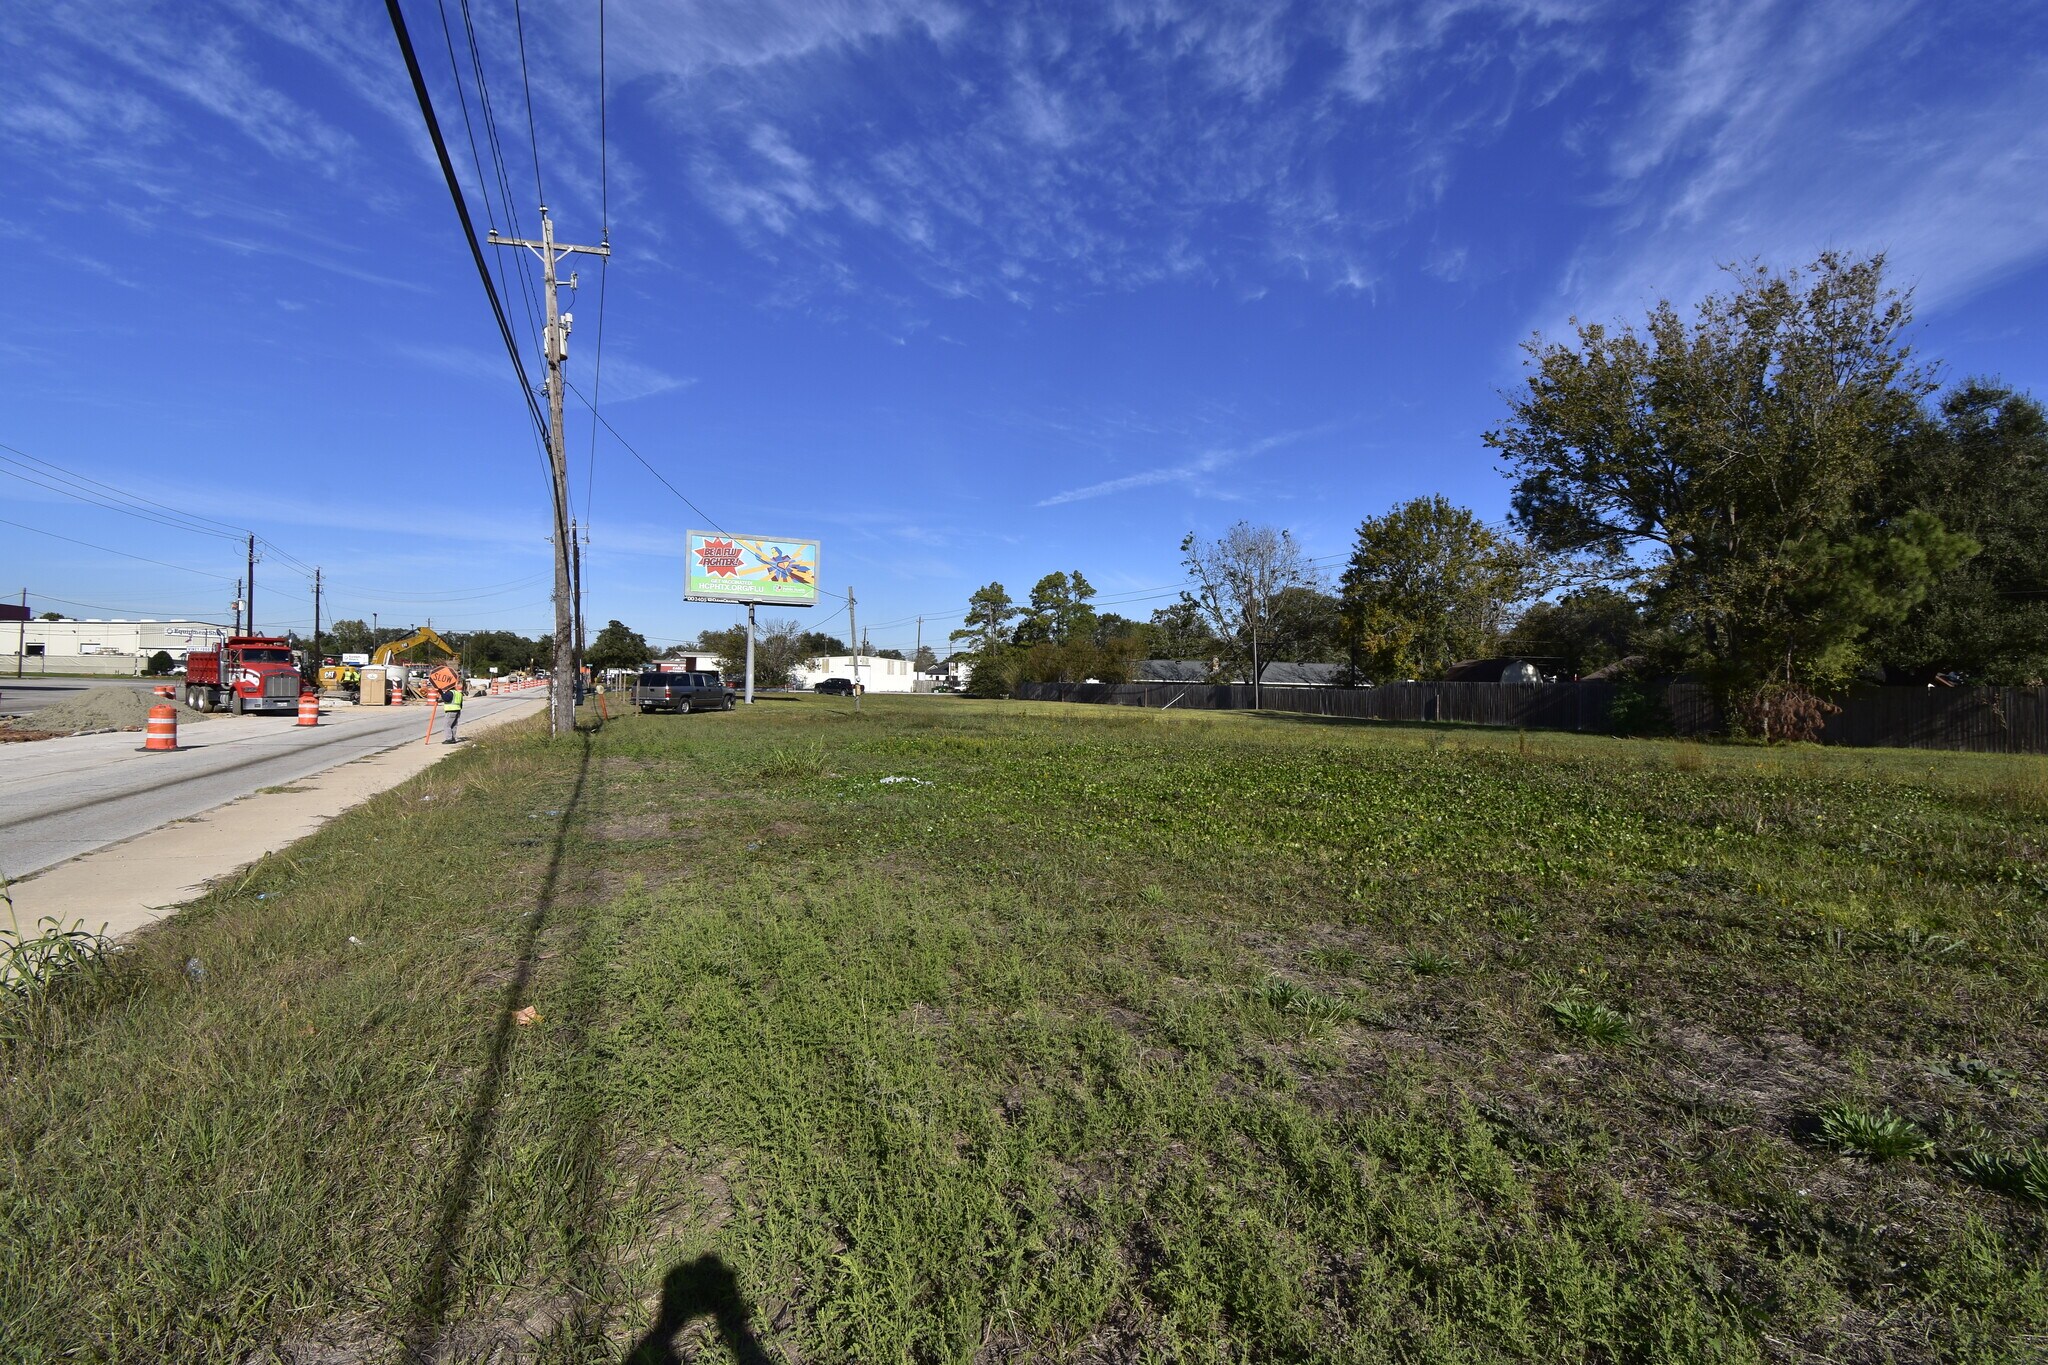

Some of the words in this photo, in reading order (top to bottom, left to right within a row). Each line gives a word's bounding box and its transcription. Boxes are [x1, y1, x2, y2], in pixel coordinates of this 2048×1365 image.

[704, 548, 714, 556] BE
[715, 548, 721, 556] A
[723, 548, 737, 556] FLU
[703, 557, 739, 566] FIGHTER!
[699, 583, 763, 592] HCPHTX.ORG/FLU
[433, 673, 453, 683] SLOW
